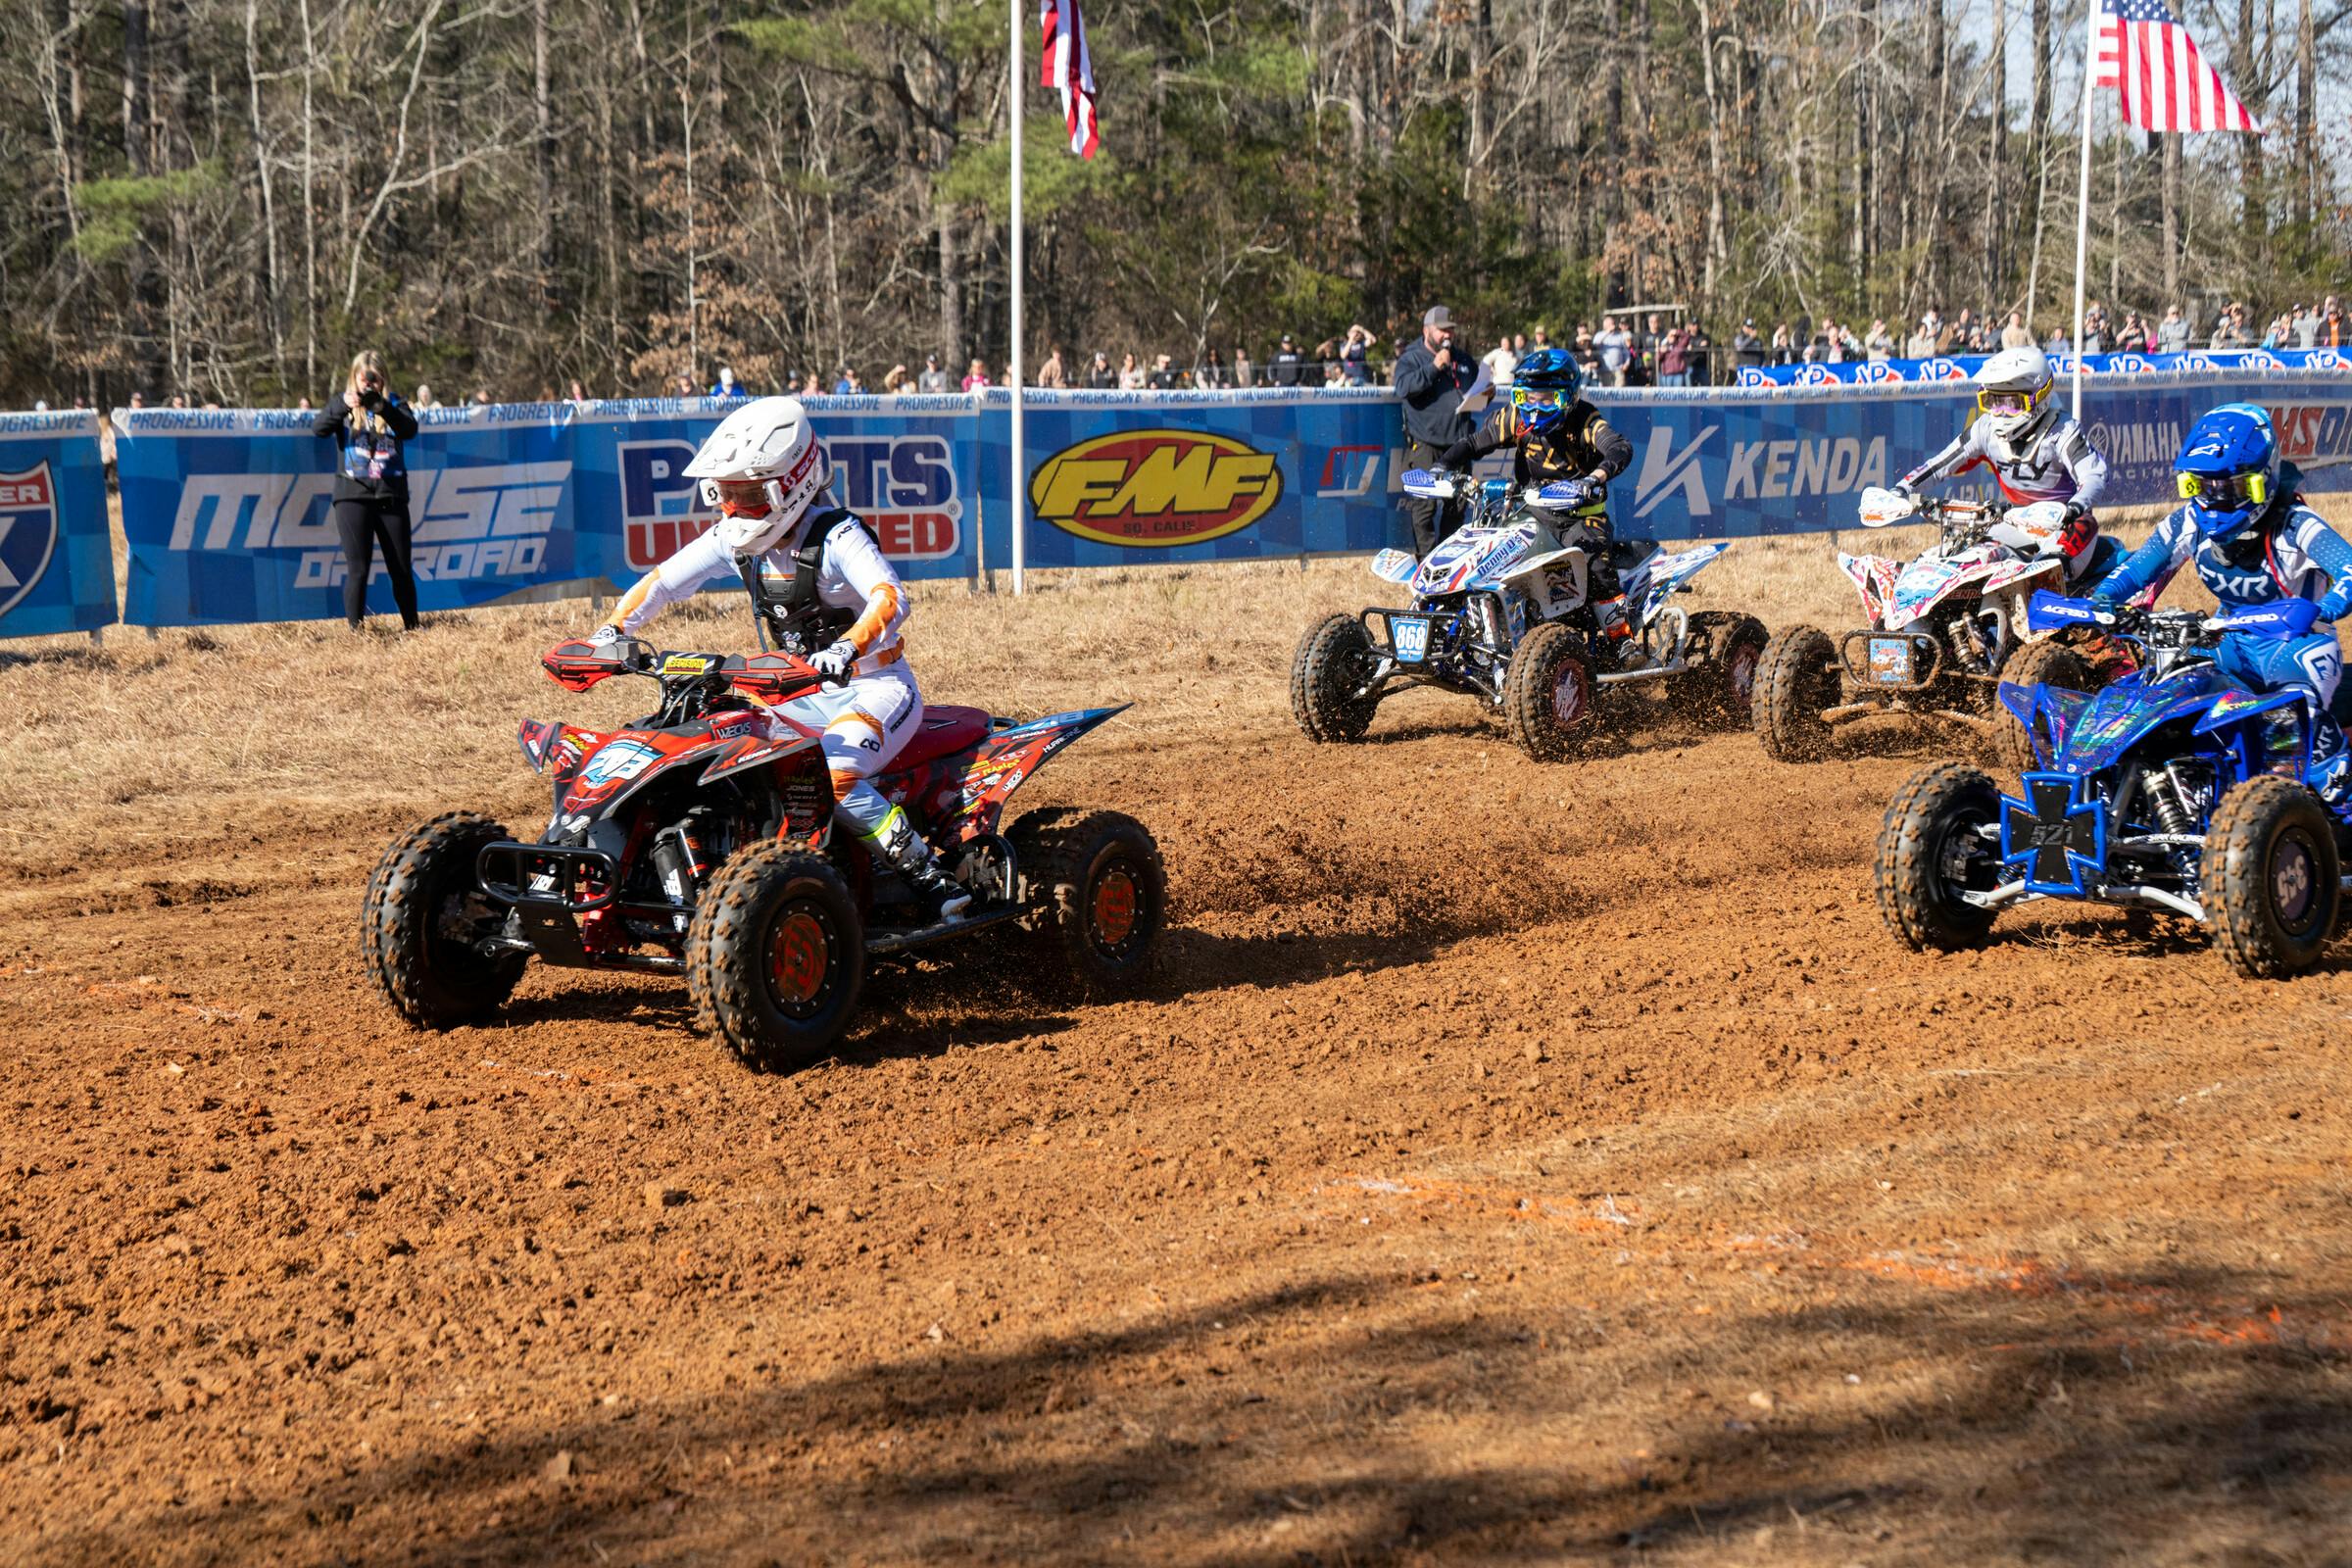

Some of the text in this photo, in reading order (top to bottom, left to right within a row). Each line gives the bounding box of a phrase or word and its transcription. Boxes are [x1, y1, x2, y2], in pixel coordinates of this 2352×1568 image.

[128, 412, 234, 429] PROGRESSIVE
[894, 395, 973, 411] PROGRESSIVE
[2110, 421, 2181, 465] YAMAHA
[619, 437, 955, 519] PTS
[1036, 444, 1277, 520] FMF
[1724, 435, 1886, 500] KENDA
[169, 461, 573, 551] MOSE
[2198, 564, 2270, 599] FXR
[1396, 624, 1426, 651] 868
[2030, 822, 2074, 847] 521
